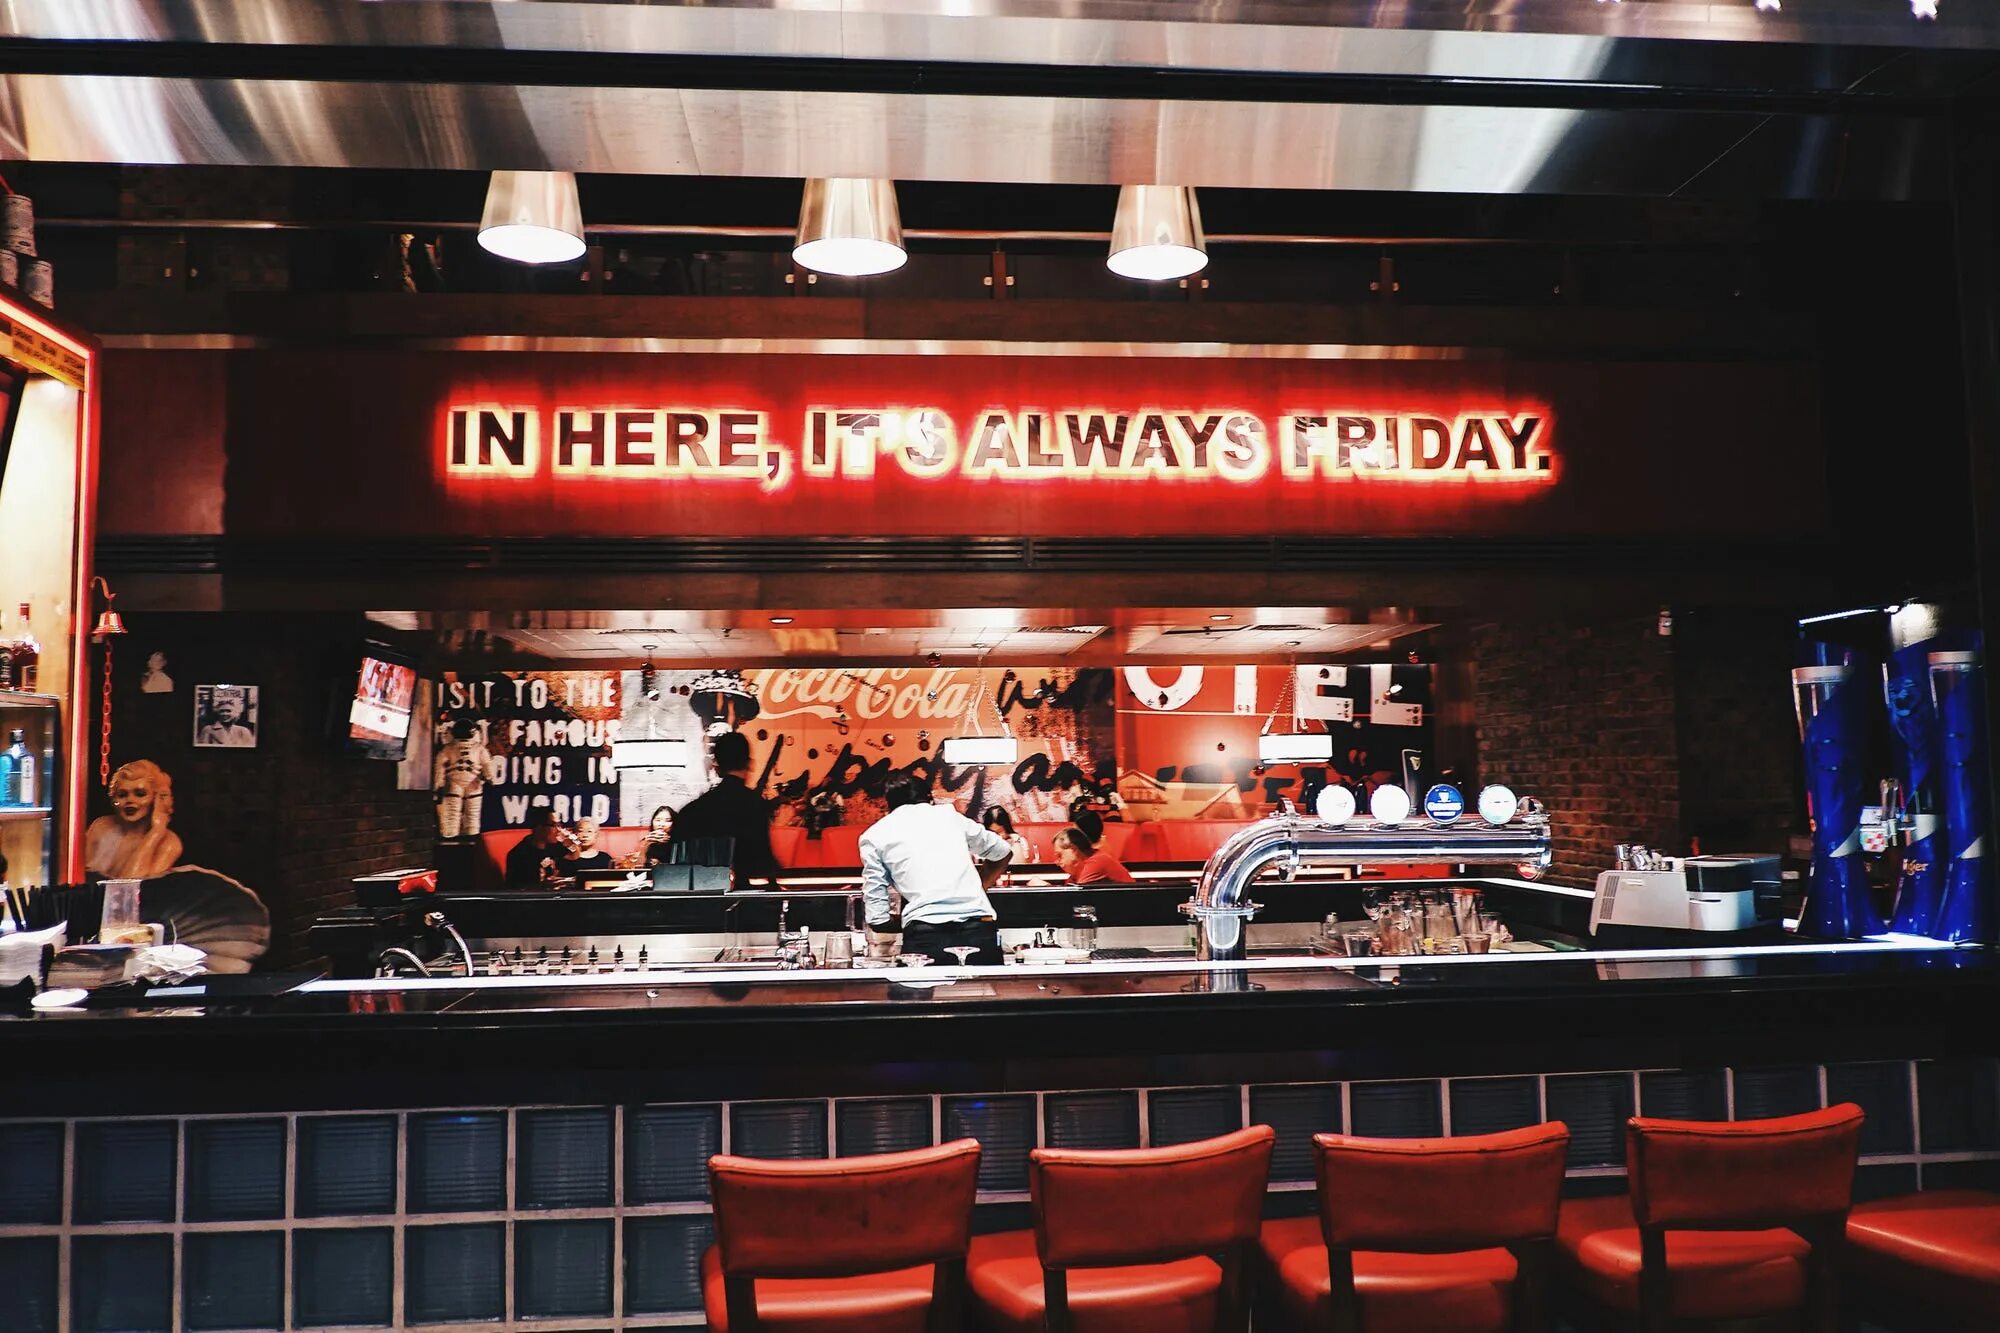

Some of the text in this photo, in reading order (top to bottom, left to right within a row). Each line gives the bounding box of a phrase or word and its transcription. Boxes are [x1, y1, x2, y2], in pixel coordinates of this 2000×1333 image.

[452, 411, 1550, 481] IN HERE, IT'S ALWAYS FRIDAY.
[437, 678, 617, 710] ISIT TO THE
[587, 756, 618, 785] IN
